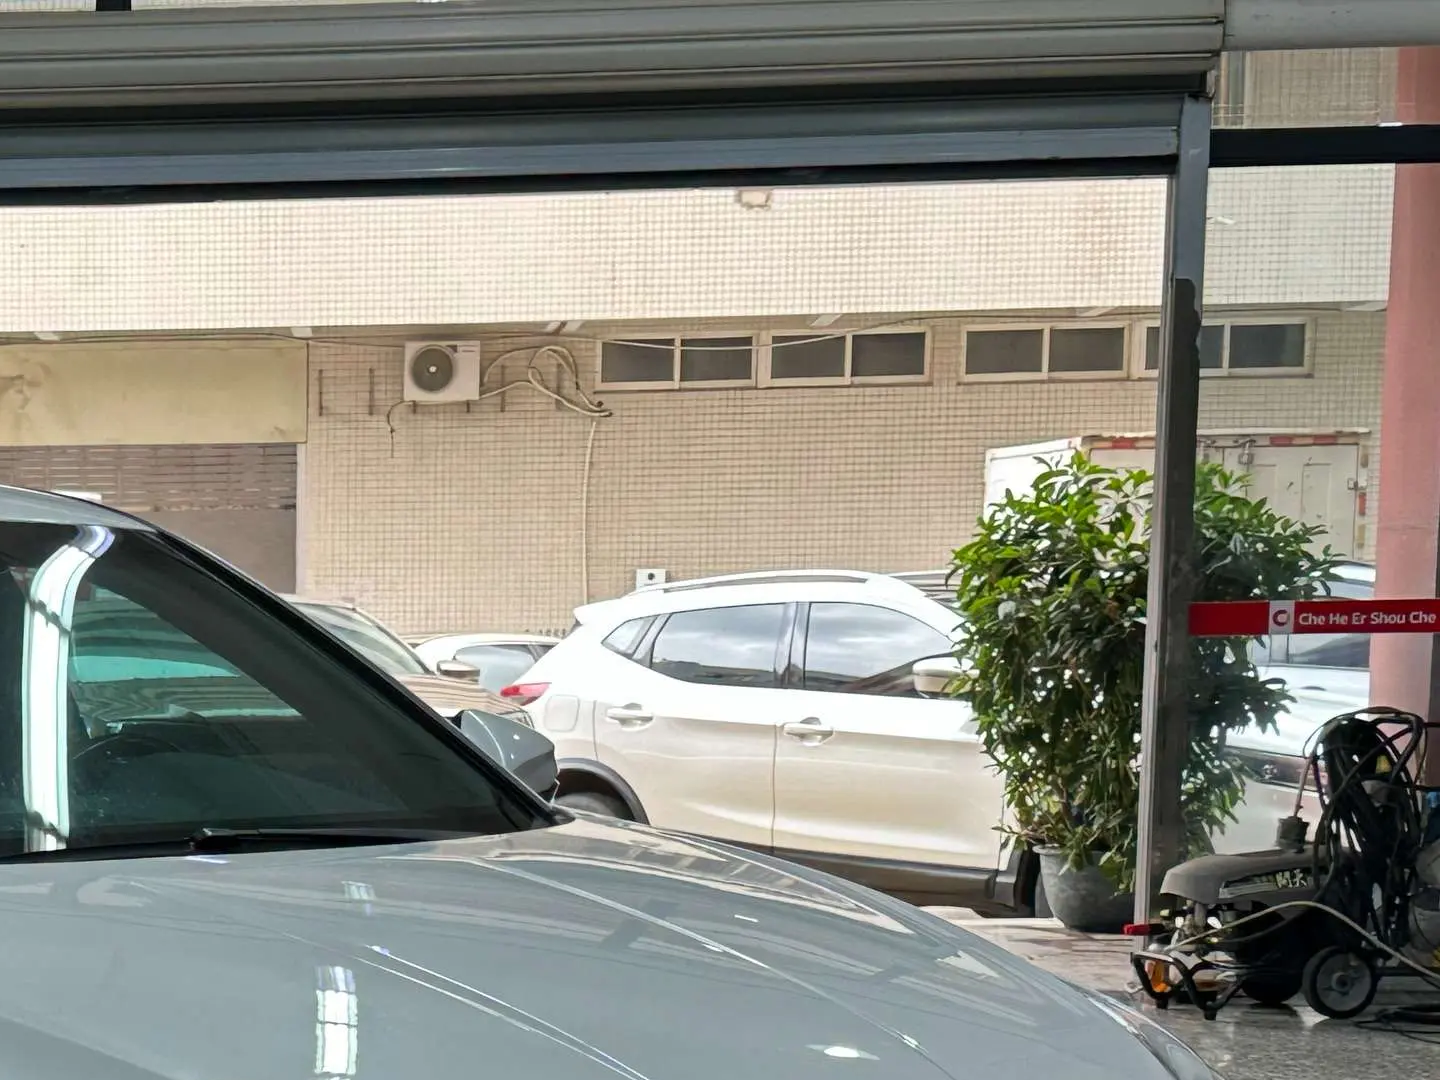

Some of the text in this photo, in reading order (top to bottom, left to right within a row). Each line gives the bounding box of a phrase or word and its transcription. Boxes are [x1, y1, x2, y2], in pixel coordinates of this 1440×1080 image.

[1298, 611, 1437, 625] Che He Er Shou Che
